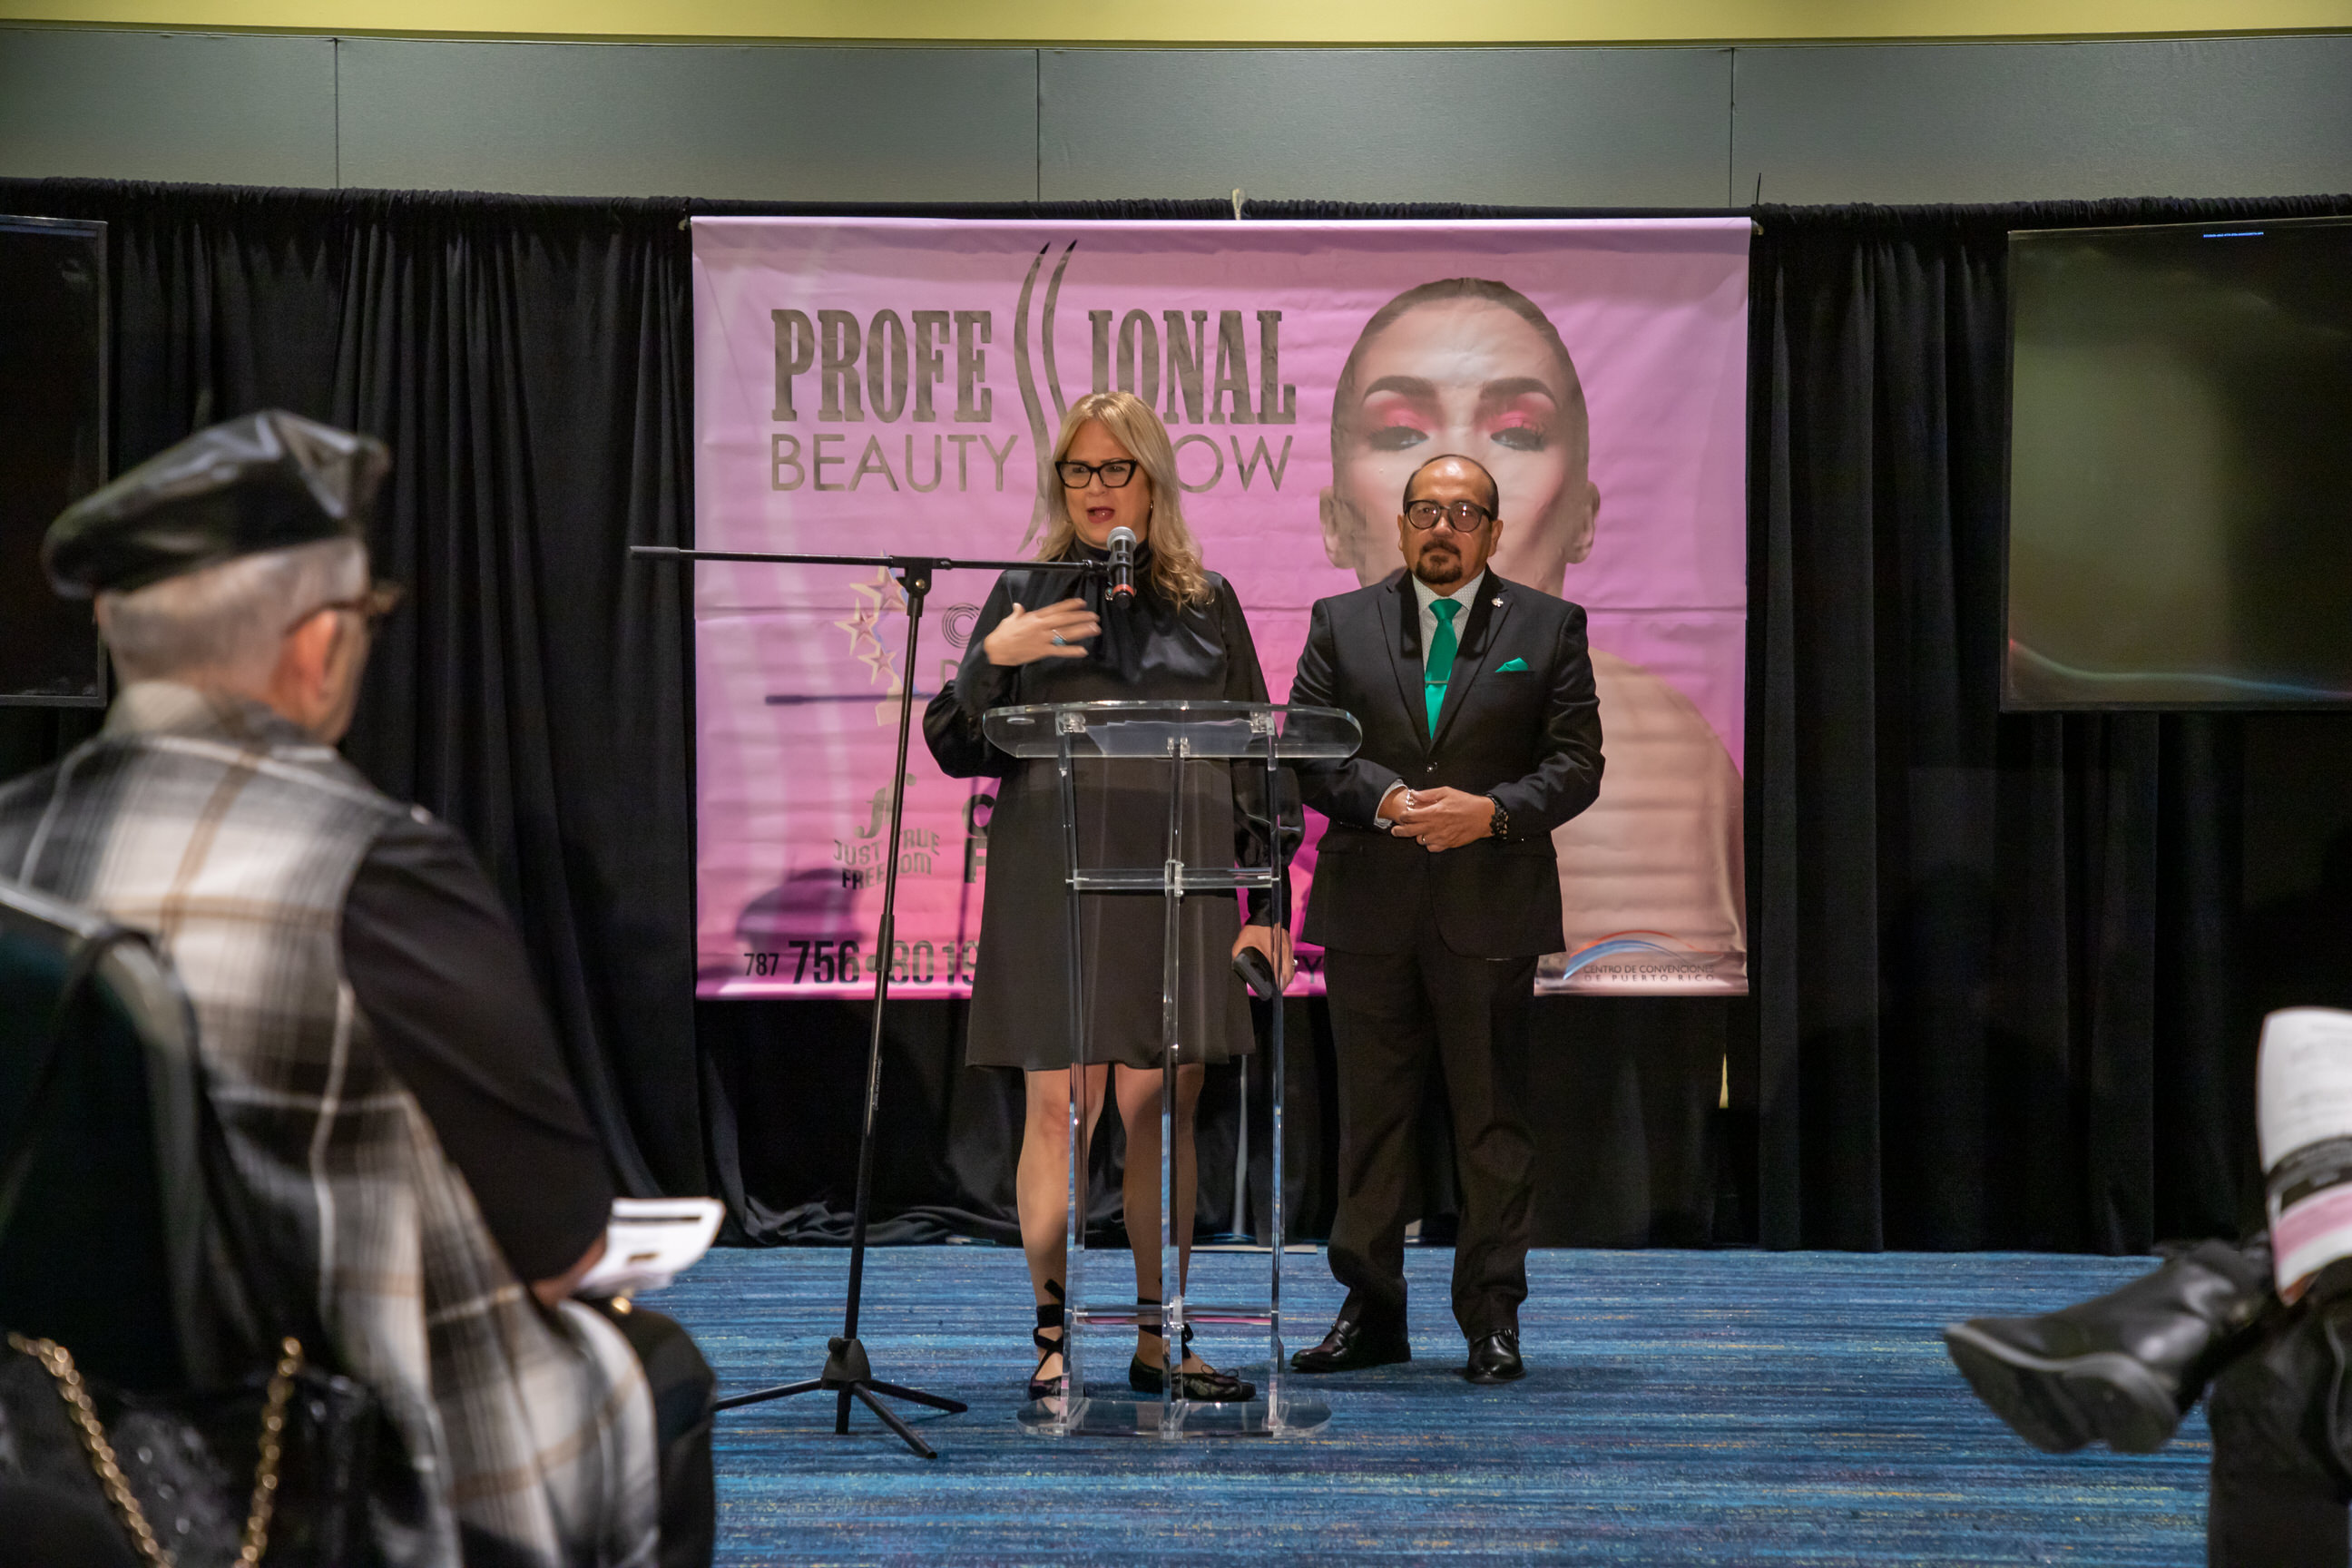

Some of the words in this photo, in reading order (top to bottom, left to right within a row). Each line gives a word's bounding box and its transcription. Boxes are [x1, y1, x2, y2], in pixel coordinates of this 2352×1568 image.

[770, 433, 1019, 492] BEAUTY
[1175, 433, 1294, 493] OW
[834, 838, 883, 866] JUST
[899, 828, 940, 857] RUE
[842, 851, 932, 890] FREEOM
[743, 953, 779, 976] 787
[1583, 965, 1622, 974] CENTRO
[1624, 965, 1637, 974] DE
[1639, 965, 1714, 974] CONVENCIONES
[1584, 974, 1602, 982] DE
[1612, 974, 1669, 982] PUERTO
[1678, 974, 1714, 982] RICO
